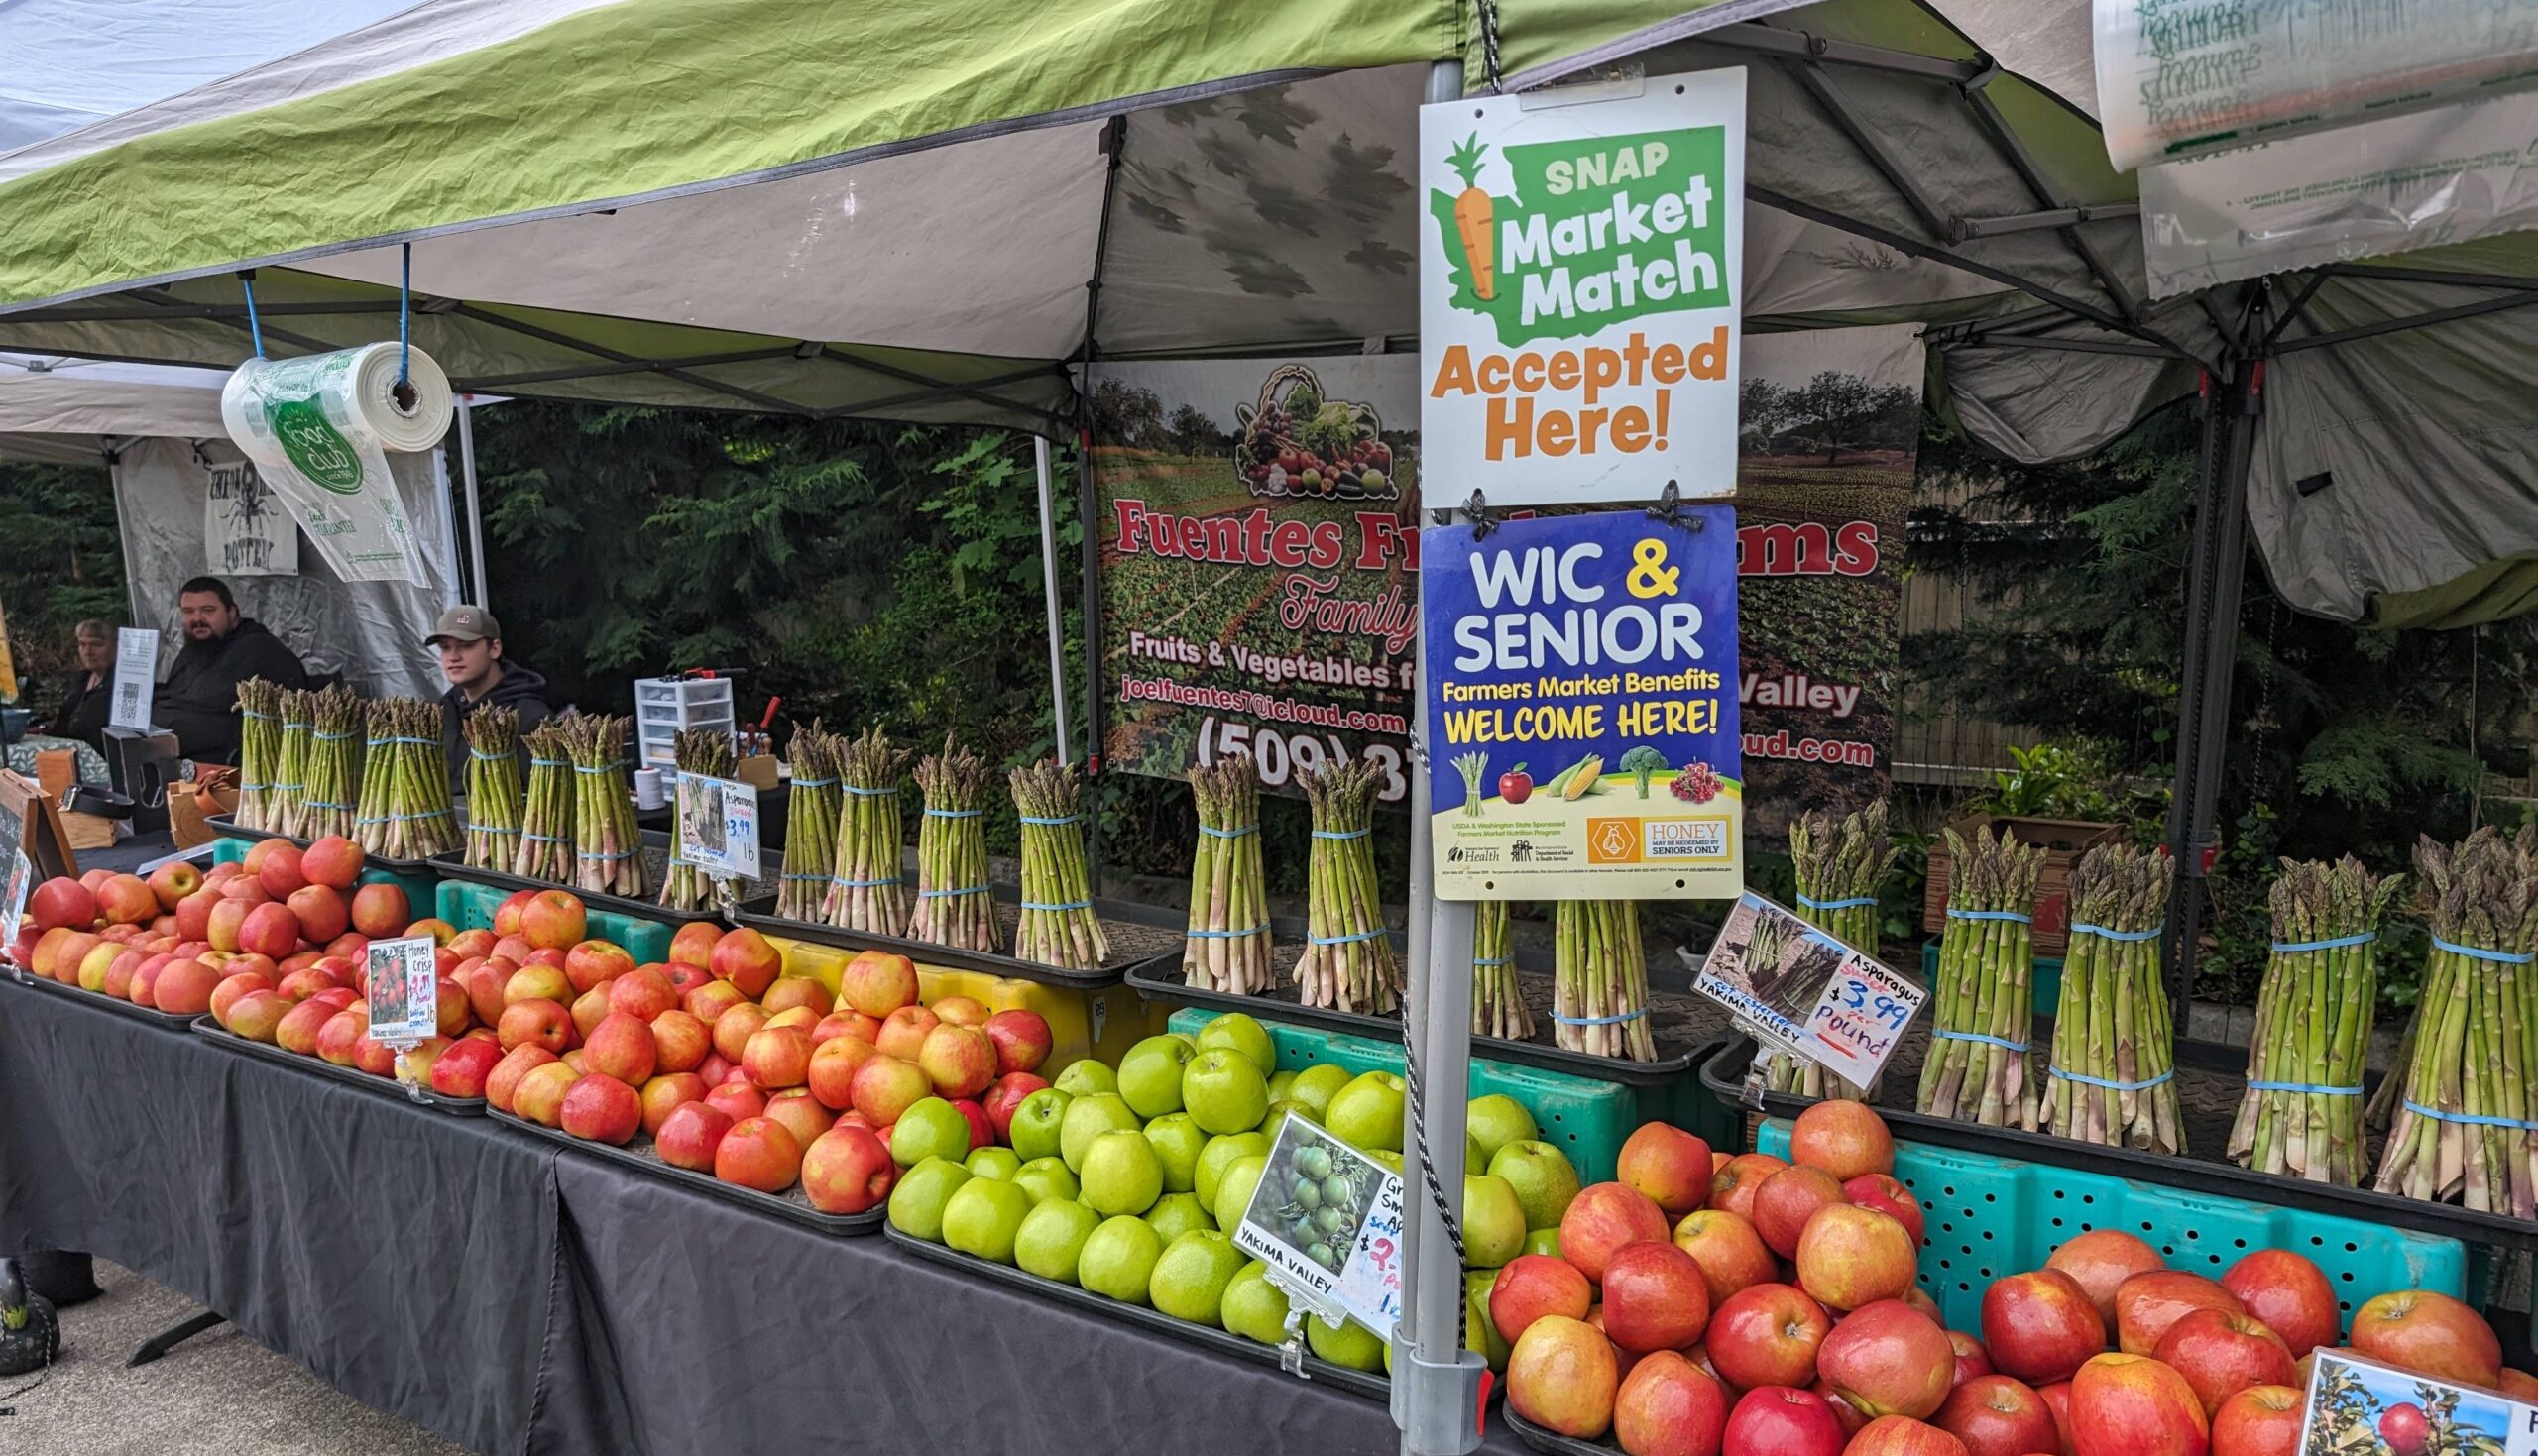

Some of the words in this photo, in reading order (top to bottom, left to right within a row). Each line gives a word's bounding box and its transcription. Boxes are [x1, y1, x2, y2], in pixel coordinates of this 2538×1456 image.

[1545, 141, 1670, 195] SNAP
[1501, 174, 1712, 274] Market
[1520, 238, 1719, 326] Match
[1430, 325, 1729, 404] Accepted
[1484, 388, 1672, 462] Here!
[308, 442, 350, 471] club
[1113, 498, 1342, 569] Fuentes
[1469, 542, 1605, 609] WIC
[1626, 538, 1680, 599] &
[1280, 573, 1419, 655] Family
[1454, 602, 1704, 673] SENIOR
[1129, 630, 1202, 665] Fruits
[1207, 640, 1225, 667] &
[1231, 645, 1390, 689] Vegetables
[1442, 678, 1532, 703] Farmers
[1538, 673, 1621, 698] Market
[1624, 668, 1721, 694] Benefits
[1120, 673, 1407, 734] joelfuentes7@icloud.com
[1443, 704, 1605, 744] WELCOME
[1616, 698, 1719, 738] HERE!
[1465, 849, 1500, 862] Health
[1477, 822, 1515, 831] Washington
[1534, 829, 1561, 838] Program
[1652, 823, 1720, 840] HONEY
[1653, 846, 1693, 855] SENIORS
[1694, 845, 1720, 854] ONLY
[1698, 977, 1748, 1014] YAKIMA
[1752, 1011, 1800, 1043] VALLEY
[1850, 953, 1921, 1007] Asparagus
[1241, 1226, 1284, 1265] YAKIMA
[1288, 1261, 1333, 1294] VALLEY
